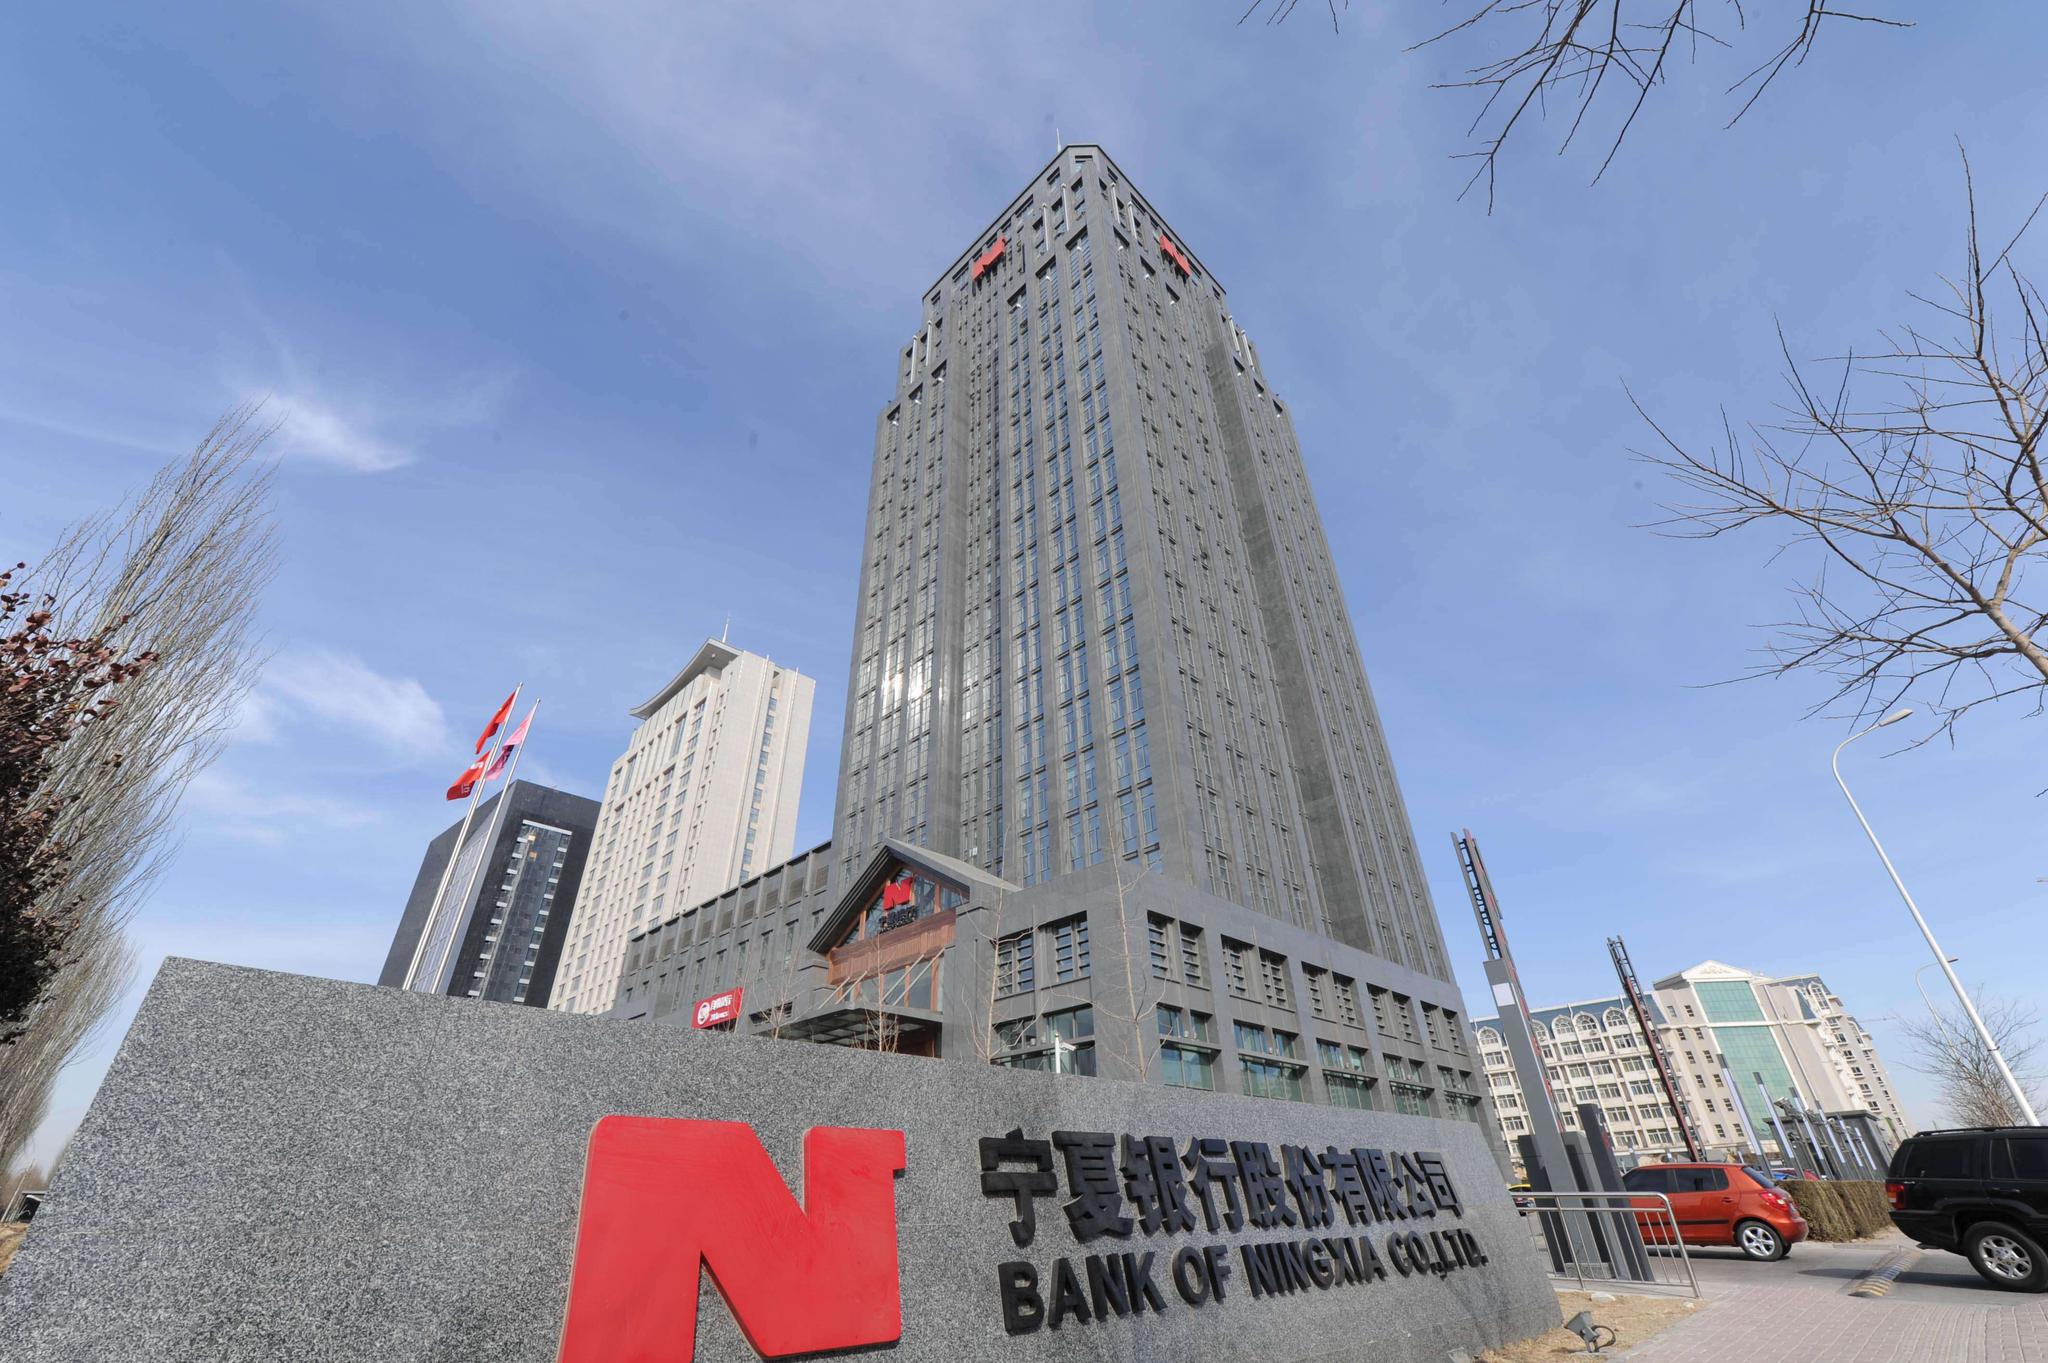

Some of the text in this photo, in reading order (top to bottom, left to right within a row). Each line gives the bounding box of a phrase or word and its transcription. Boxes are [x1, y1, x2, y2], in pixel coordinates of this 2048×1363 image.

[979, 1128, 1464, 1247] 宁夏银行股份有限公司
[998, 1251, 1168, 1336] BANK
[1172, 1245, 1231, 1305] OF
[1240, 1236, 1388, 1299] NINGXIA
